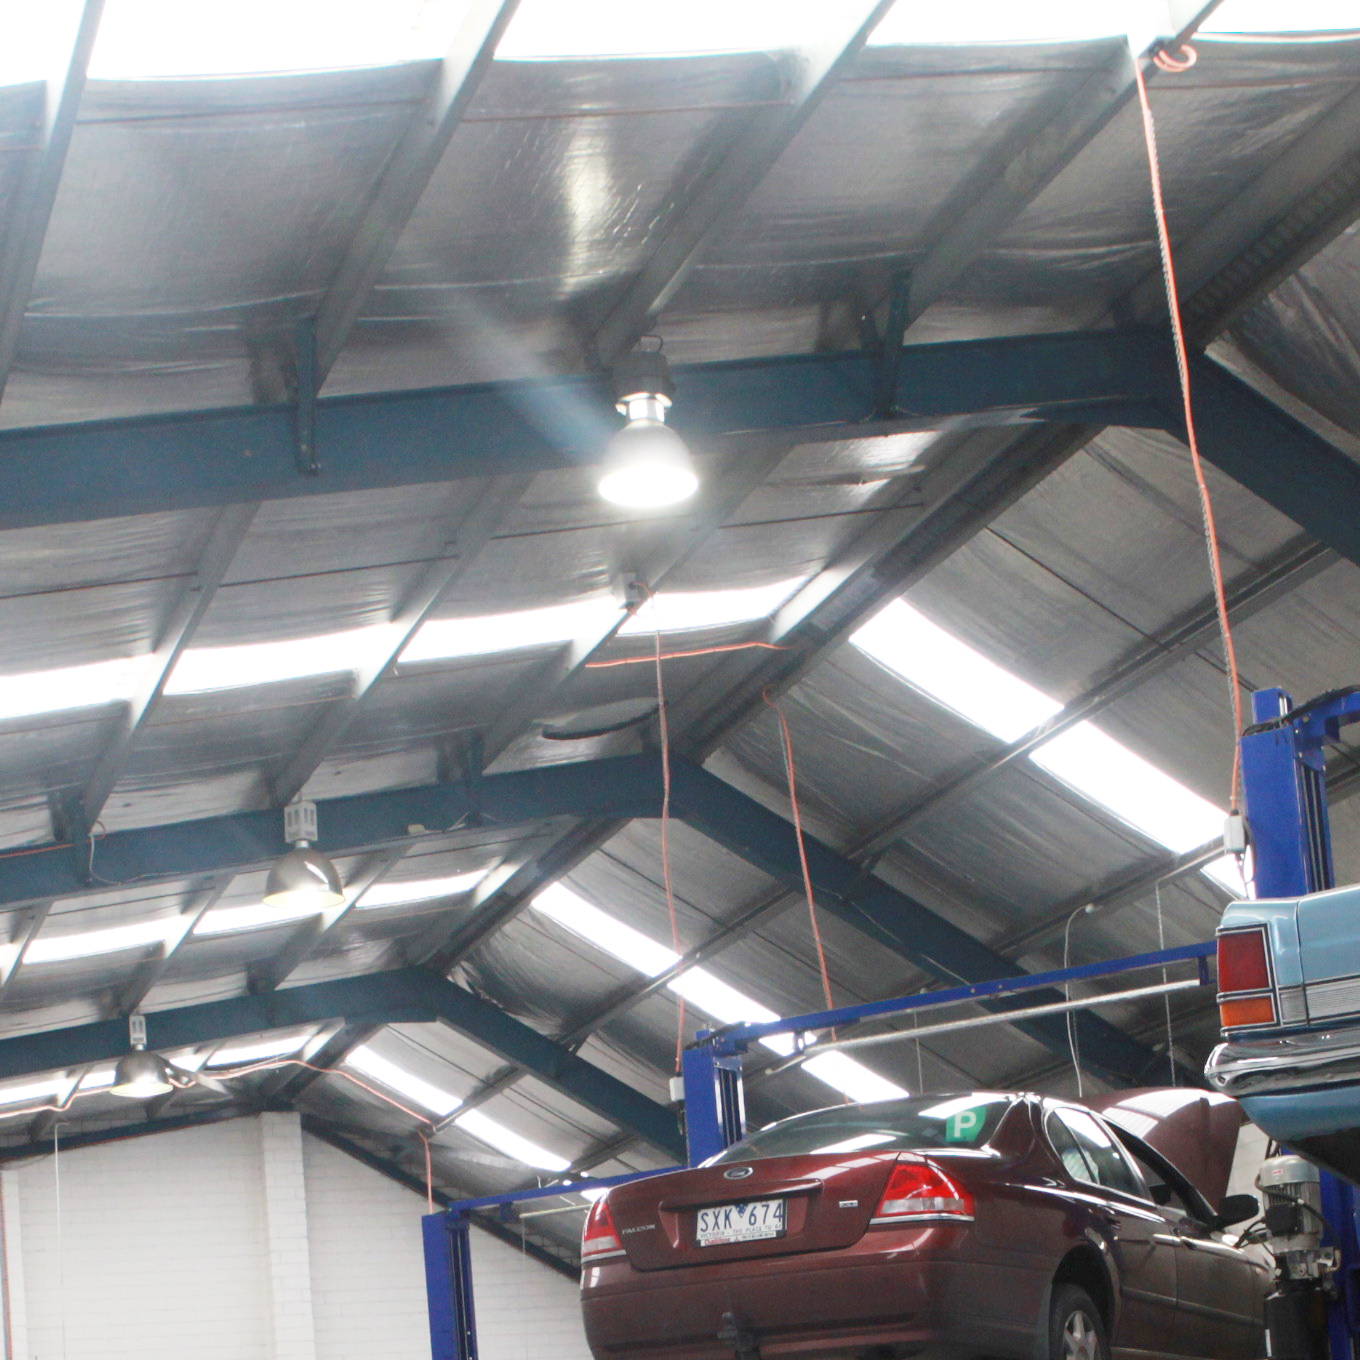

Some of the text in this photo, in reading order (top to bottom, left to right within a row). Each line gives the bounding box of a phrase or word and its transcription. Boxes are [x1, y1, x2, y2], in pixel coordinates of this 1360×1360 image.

[953, 1110, 977, 1137] P
[622, 1223, 656, 1235] FALCON
[700, 1202, 784, 1233] SXK 674
